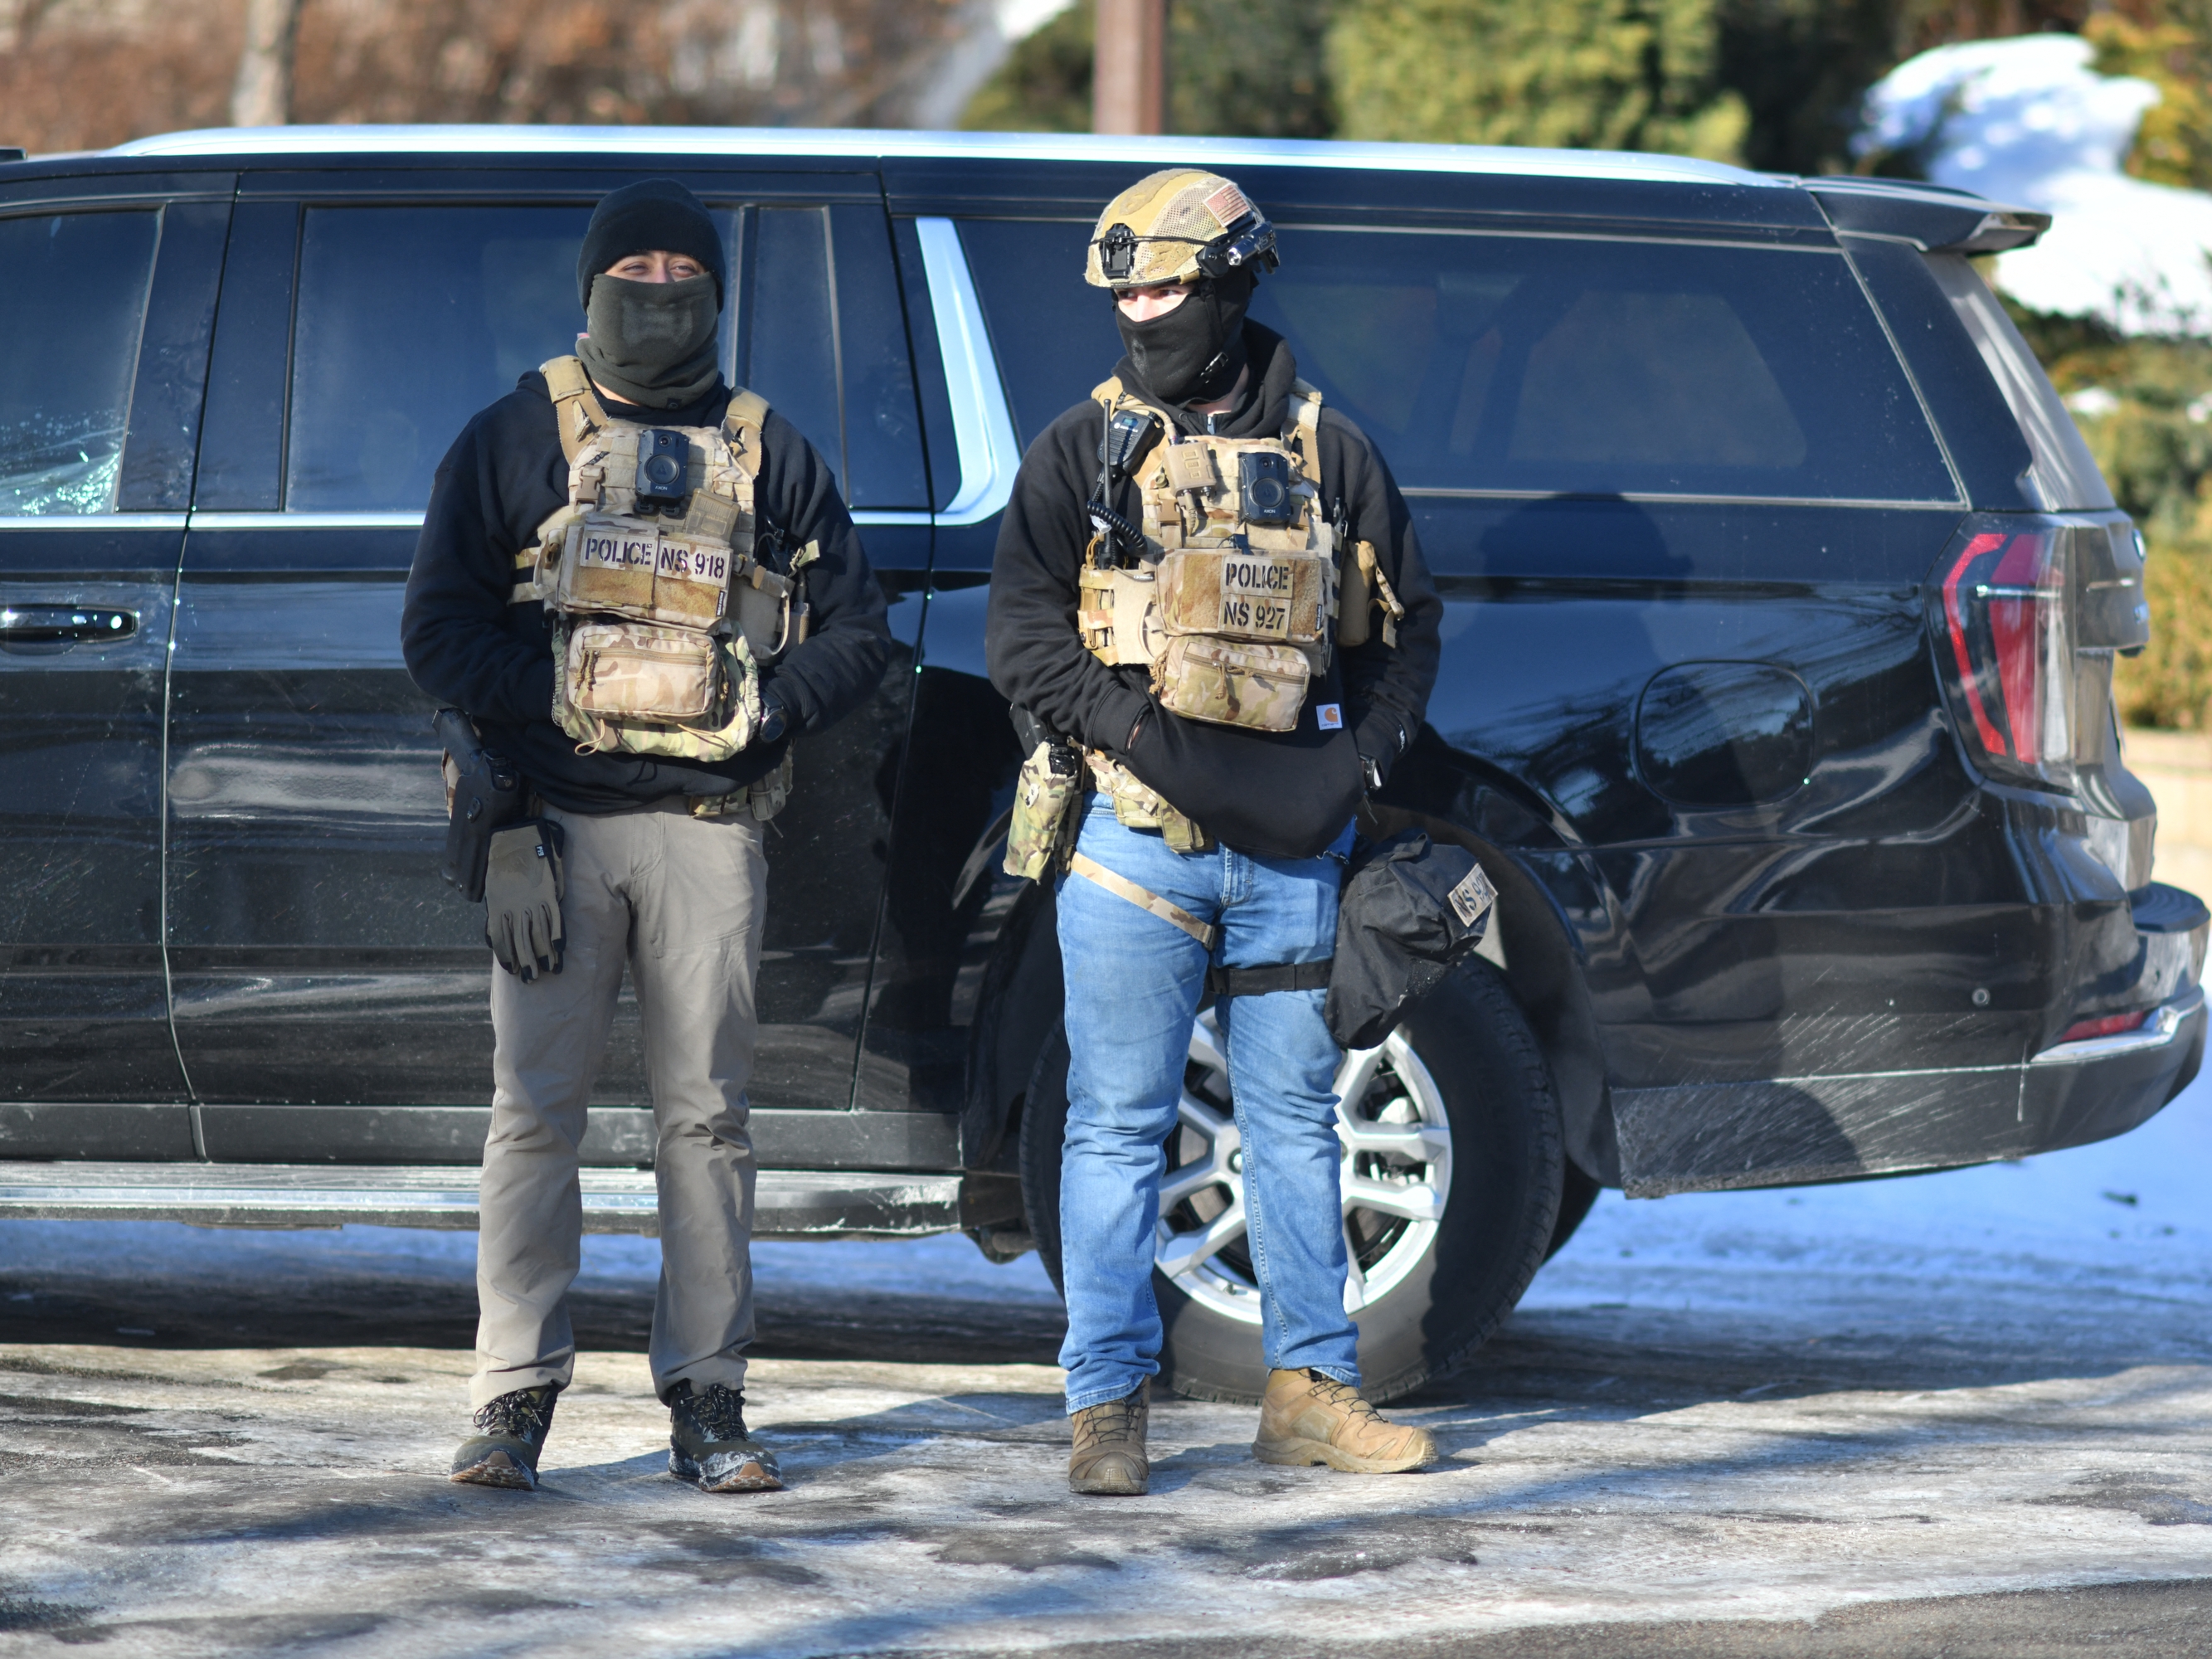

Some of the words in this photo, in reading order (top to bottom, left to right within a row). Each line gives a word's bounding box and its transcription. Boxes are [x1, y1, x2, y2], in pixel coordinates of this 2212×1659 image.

[585, 538, 653, 566] POLICE
[660, 547, 688, 572] NS
[694, 552, 725, 579] 918
[1225, 562, 1289, 590] POLICE
[1223, 601, 1249, 627] NS
[1255, 605, 1286, 630] 927
[1455, 888, 1477, 918] NS
